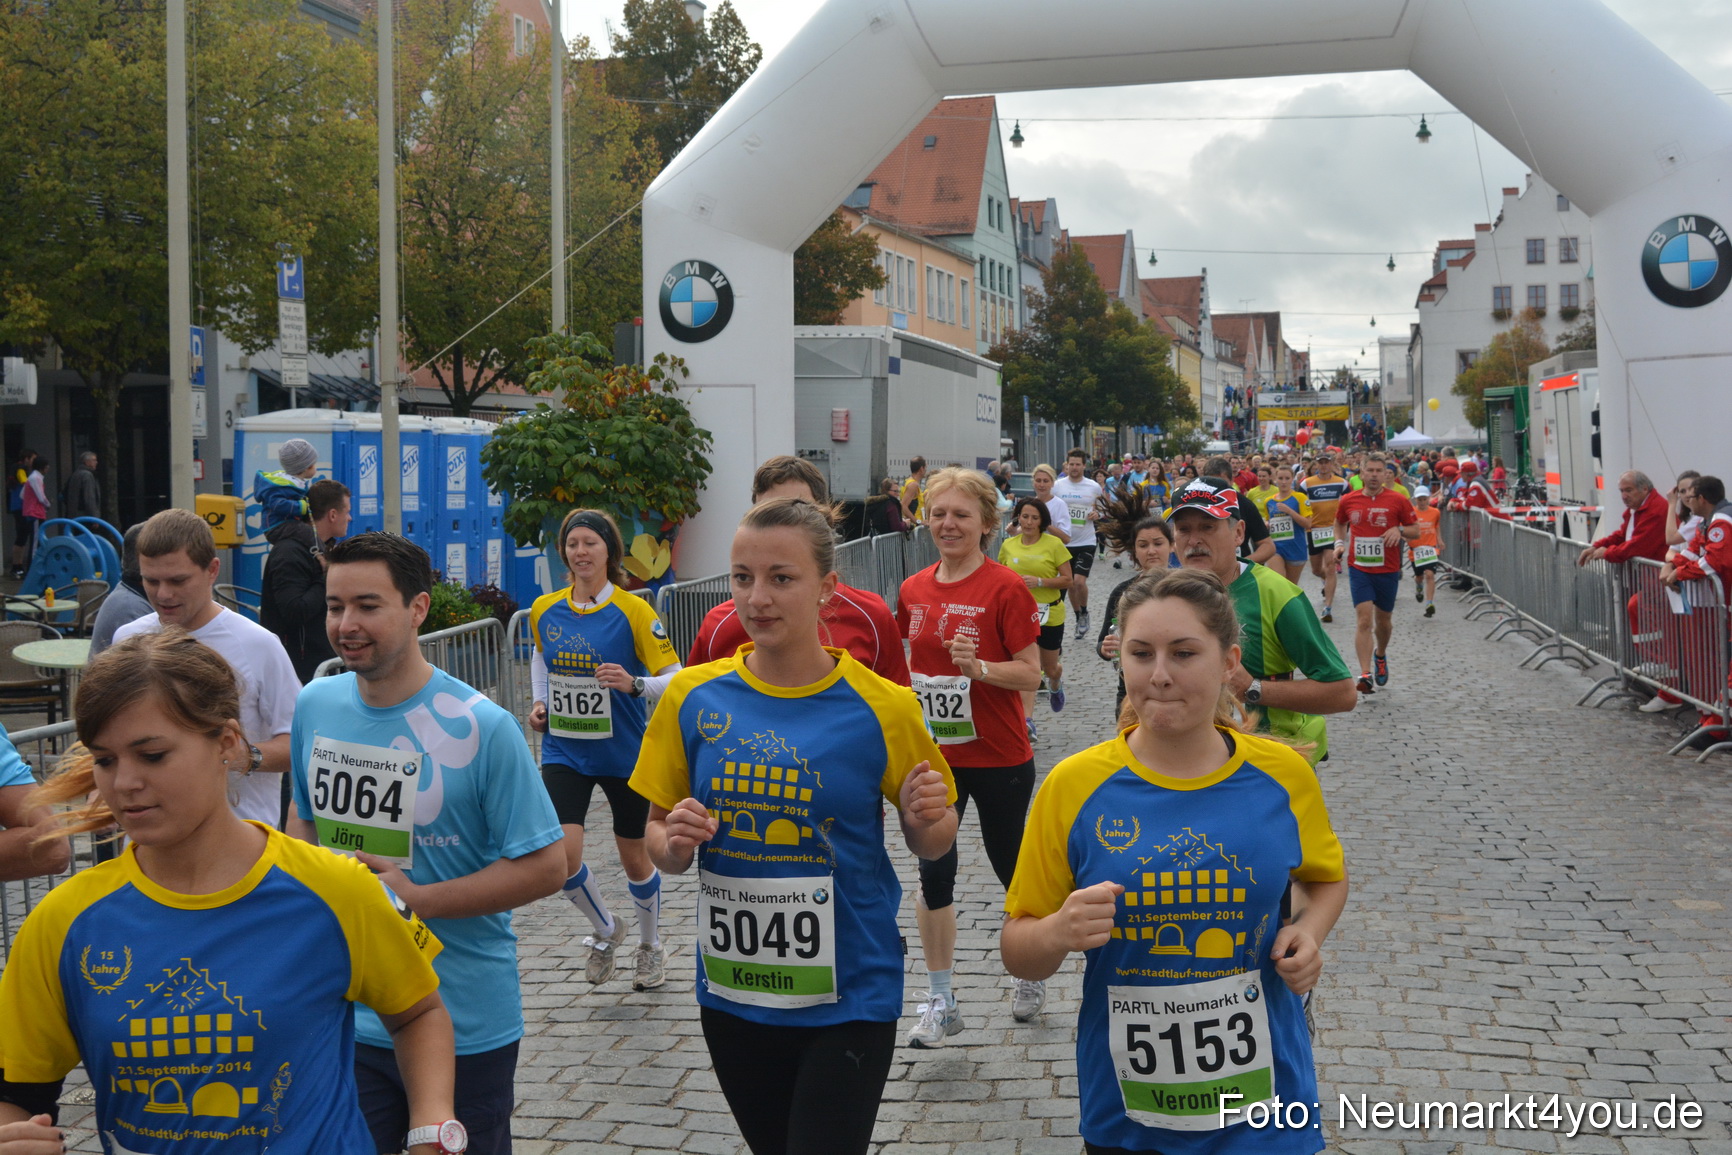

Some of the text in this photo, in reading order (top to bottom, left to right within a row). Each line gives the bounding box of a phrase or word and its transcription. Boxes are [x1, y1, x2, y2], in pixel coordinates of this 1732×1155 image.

[1648, 216, 1727, 249] BMW
[664, 261, 728, 289] BMW
[225, 409, 233, 429] 3
[1287, 409, 1319, 418] START
[360, 450, 377, 476] DIXI
[402, 450, 419, 474] DIXI
[448, 450, 466, 474] DIXI
[1270, 521, 1291, 533] 5133
[1356, 544, 1381, 555] 5116
[945, 608, 977, 617] STADTLAUF
[948, 603, 986, 613] NEUMARKTER
[565, 682, 597, 690] Neumarkt
[925, 682, 958, 690] Neumarkt
[553, 690, 604, 716] 5162
[558, 718, 600, 730] Christiane
[702, 722, 723, 730] Jahre
[932, 725, 958, 735] eresia
[312, 747, 399, 772] PARTL Neumarkt
[313, 767, 403, 823] 5064
[783, 805, 809, 817] 2014
[331, 827, 364, 851] Jörg
[413, 834, 460, 847] ndere
[1104, 830, 1131, 838] Jahre
[701, 882, 807, 904] PARTL Neumarkt
[1127, 910, 1244, 923] 21.September 2014
[709, 905, 820, 960] 5049
[100, 951, 115, 960] 15
[91, 964, 121, 974] Jahre
[732, 967, 794, 990] Kerstin
[1112, 992, 1240, 1015] PARTL Neumarkt
[1126, 1011, 1257, 1076] 5153
[118, 1061, 252, 1078] 21.September 2014
